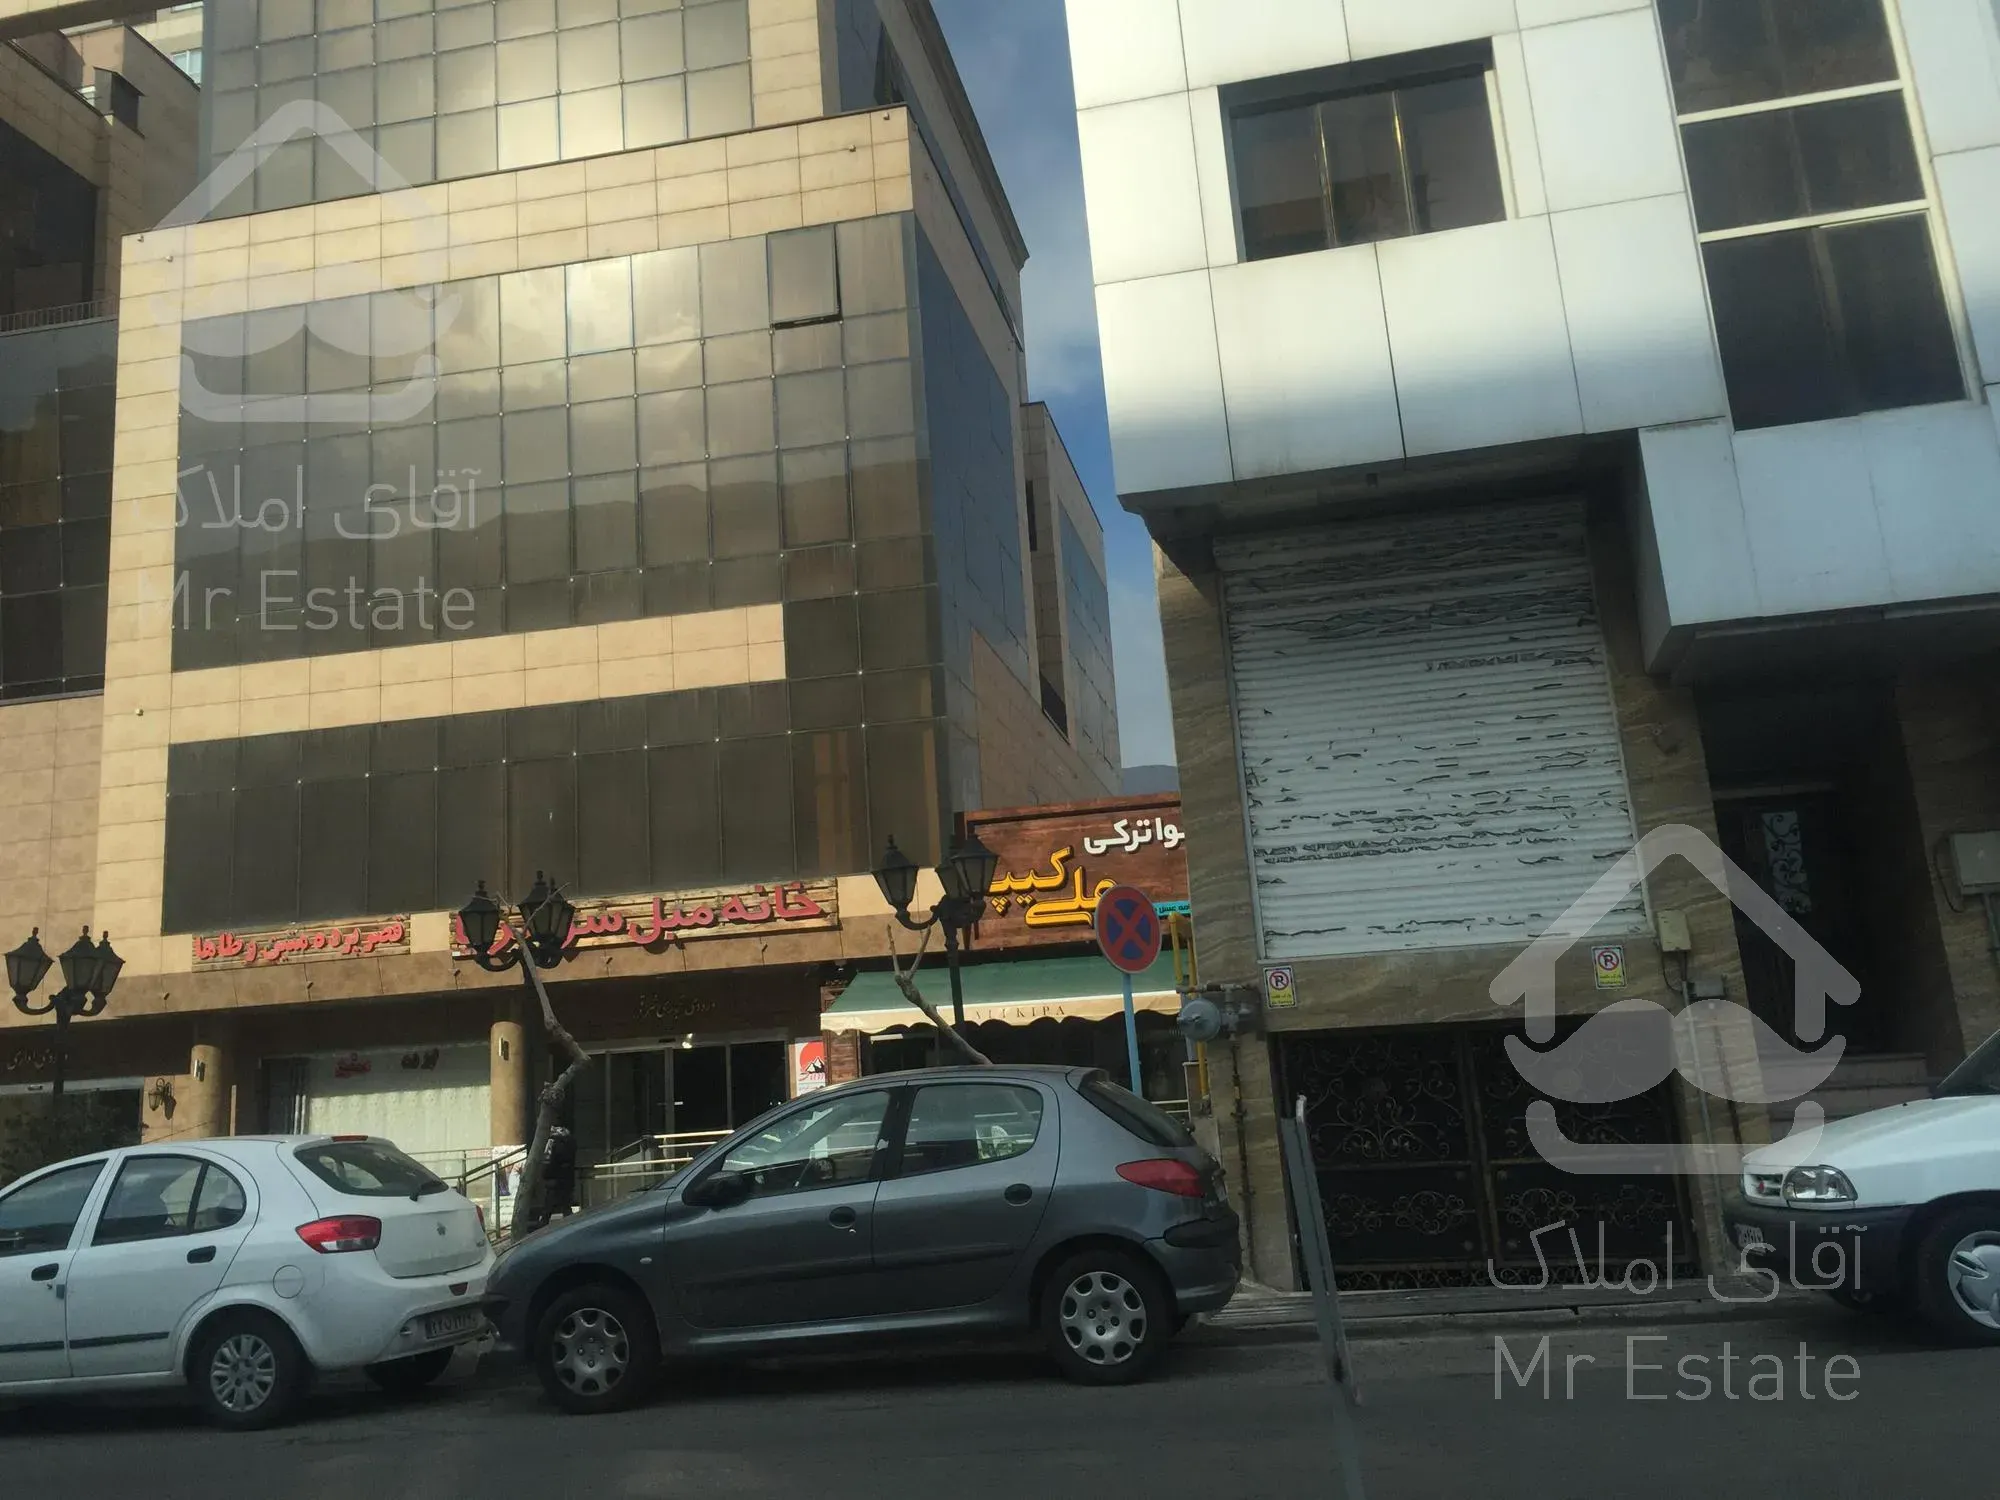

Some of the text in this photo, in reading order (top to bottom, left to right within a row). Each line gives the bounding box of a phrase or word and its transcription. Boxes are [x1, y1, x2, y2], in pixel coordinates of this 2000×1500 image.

[1083, 818, 1153, 855] ترکی
[987, 846, 1073, 914] کیپ
[627, 896, 714, 945] مبل
[721, 881, 823, 922] خانه
[312, 927, 362, 957] پرده
